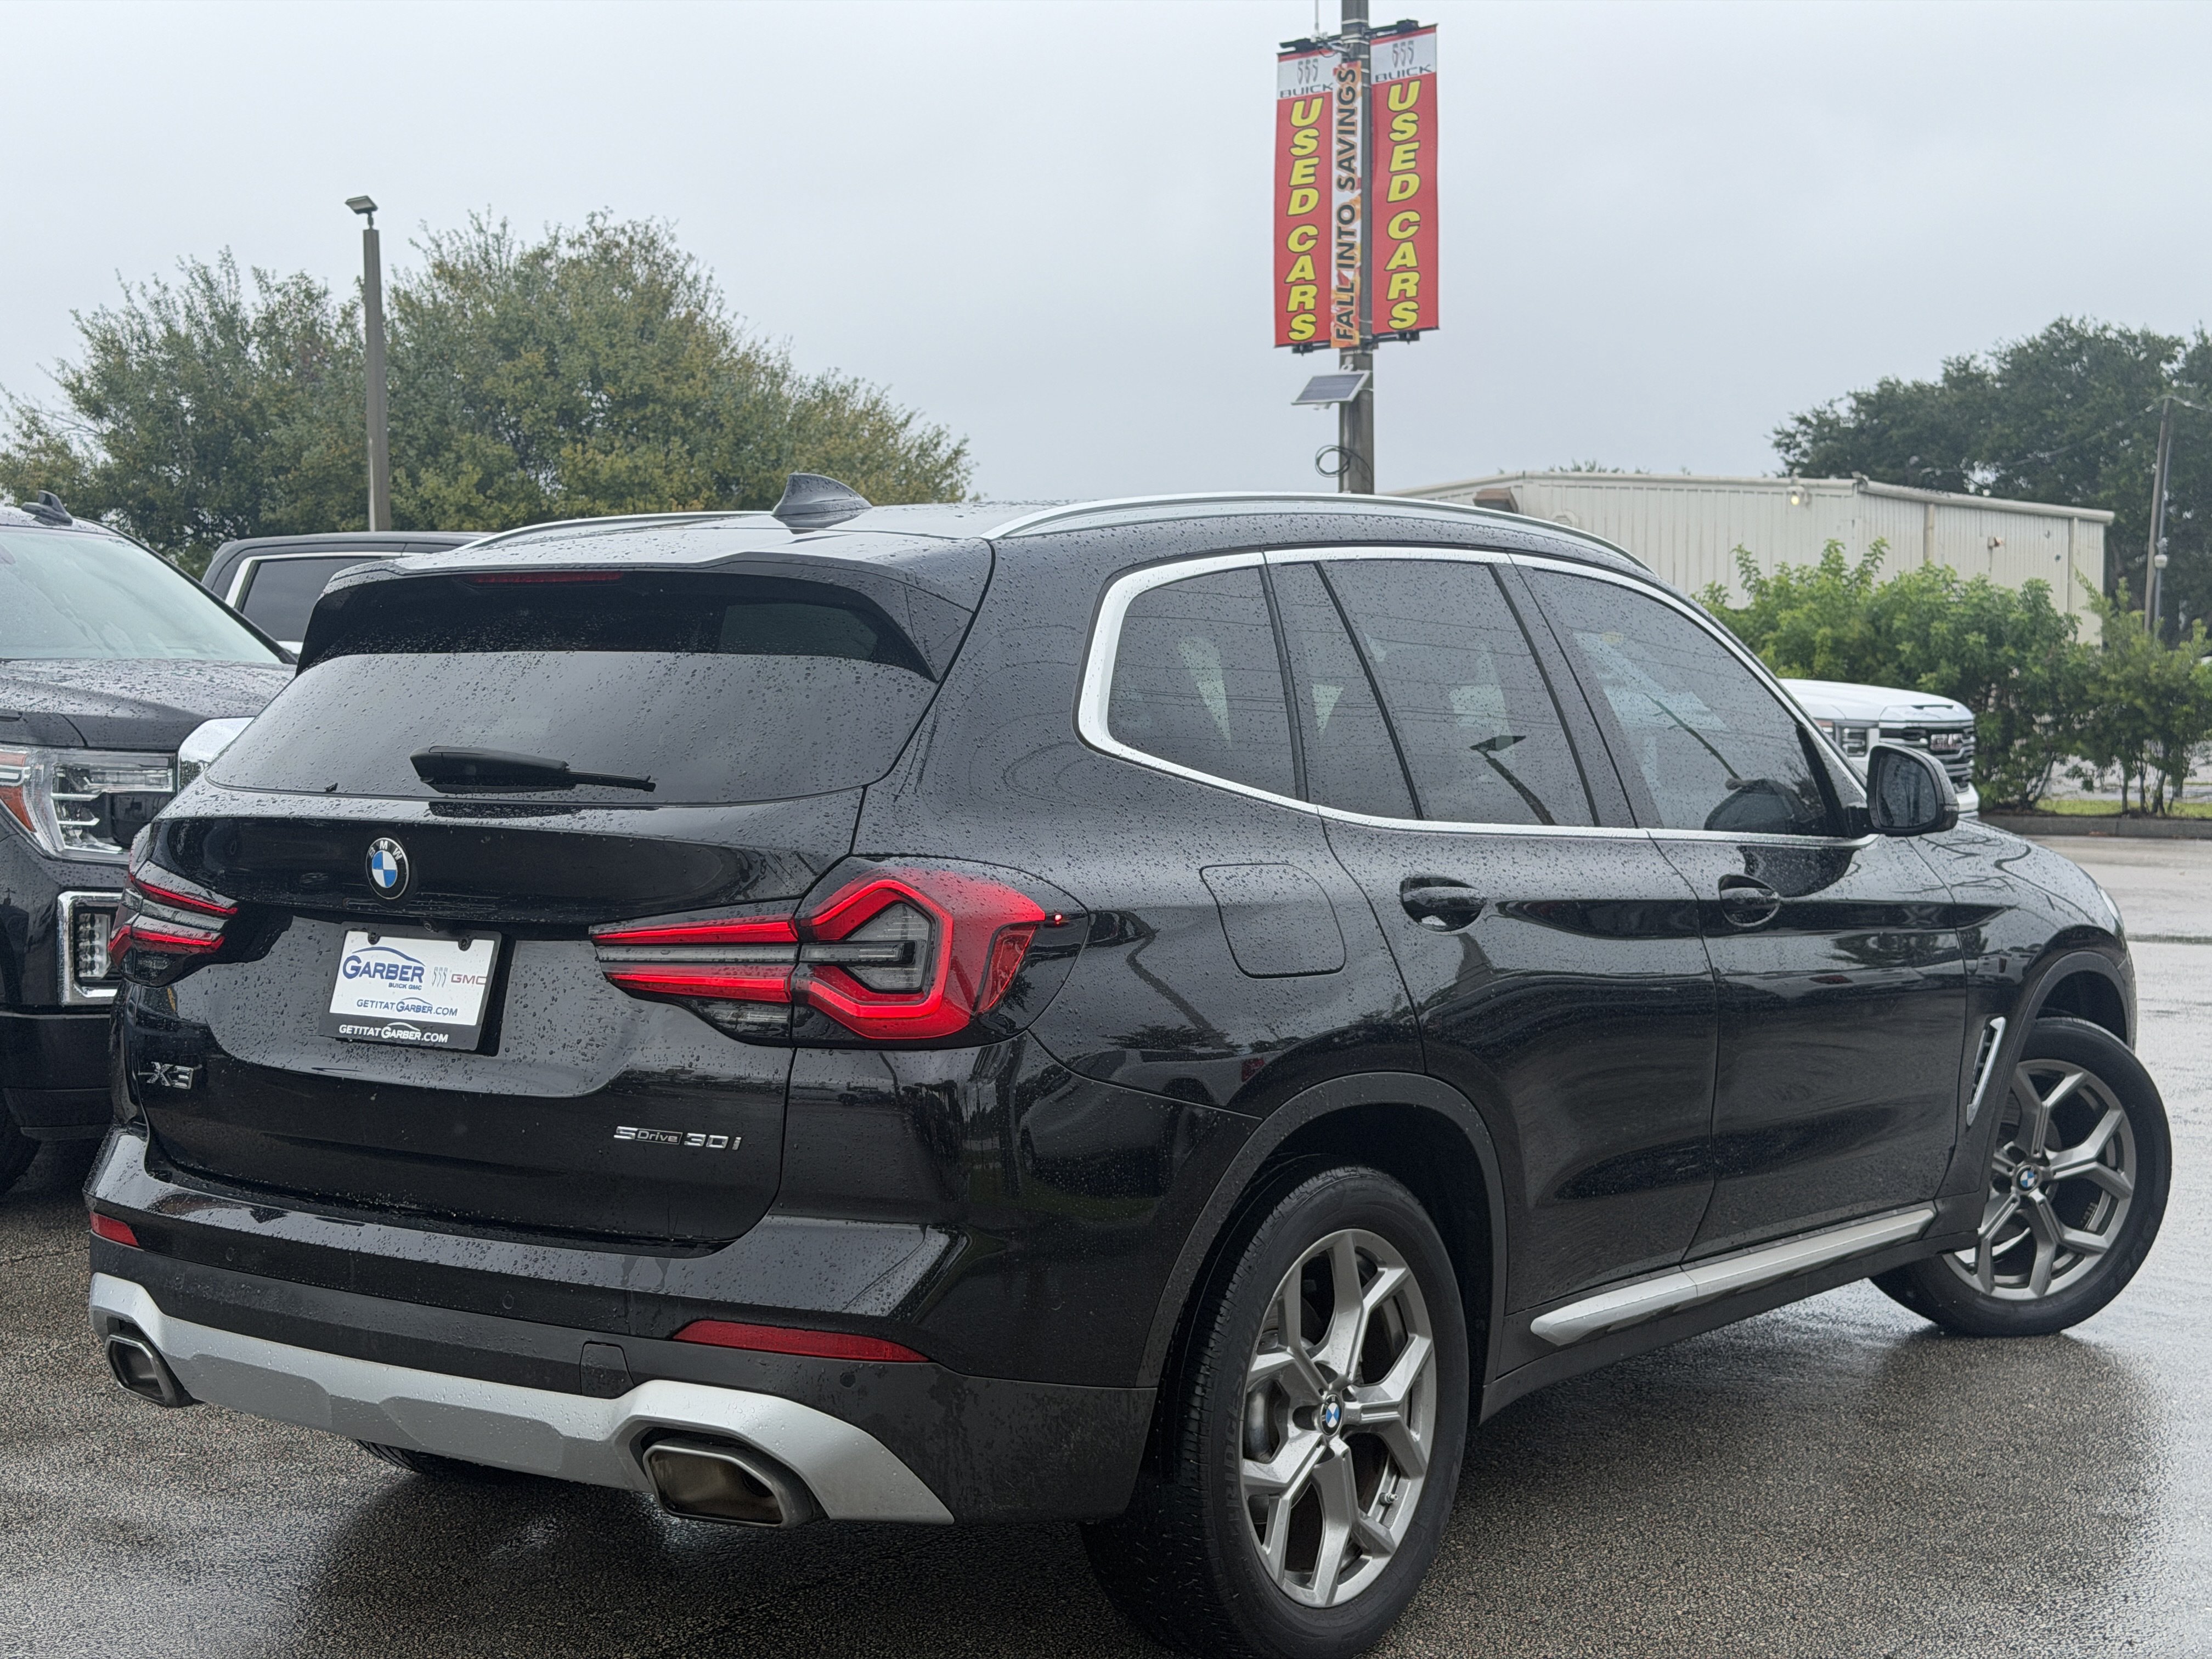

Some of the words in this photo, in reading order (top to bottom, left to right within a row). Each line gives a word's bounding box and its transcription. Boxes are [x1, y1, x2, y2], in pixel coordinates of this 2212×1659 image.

[1280, 83, 1334, 98] BUICK
[1375, 64, 1432, 82] BUICK
[1286, 97, 1324, 217] USED
[1337, 69, 1357, 191] SAVINGS
[1386, 80, 1421, 203] USED
[1336, 204, 1356, 269] INTO
[1284, 224, 1319, 341] CARS
[1384, 210, 1421, 330] CARS
[1336, 281, 1355, 340] FALL
[369, 840, 403, 860] BMW
[342, 955, 425, 983] GARBER
[450, 973, 487, 985] GMC
